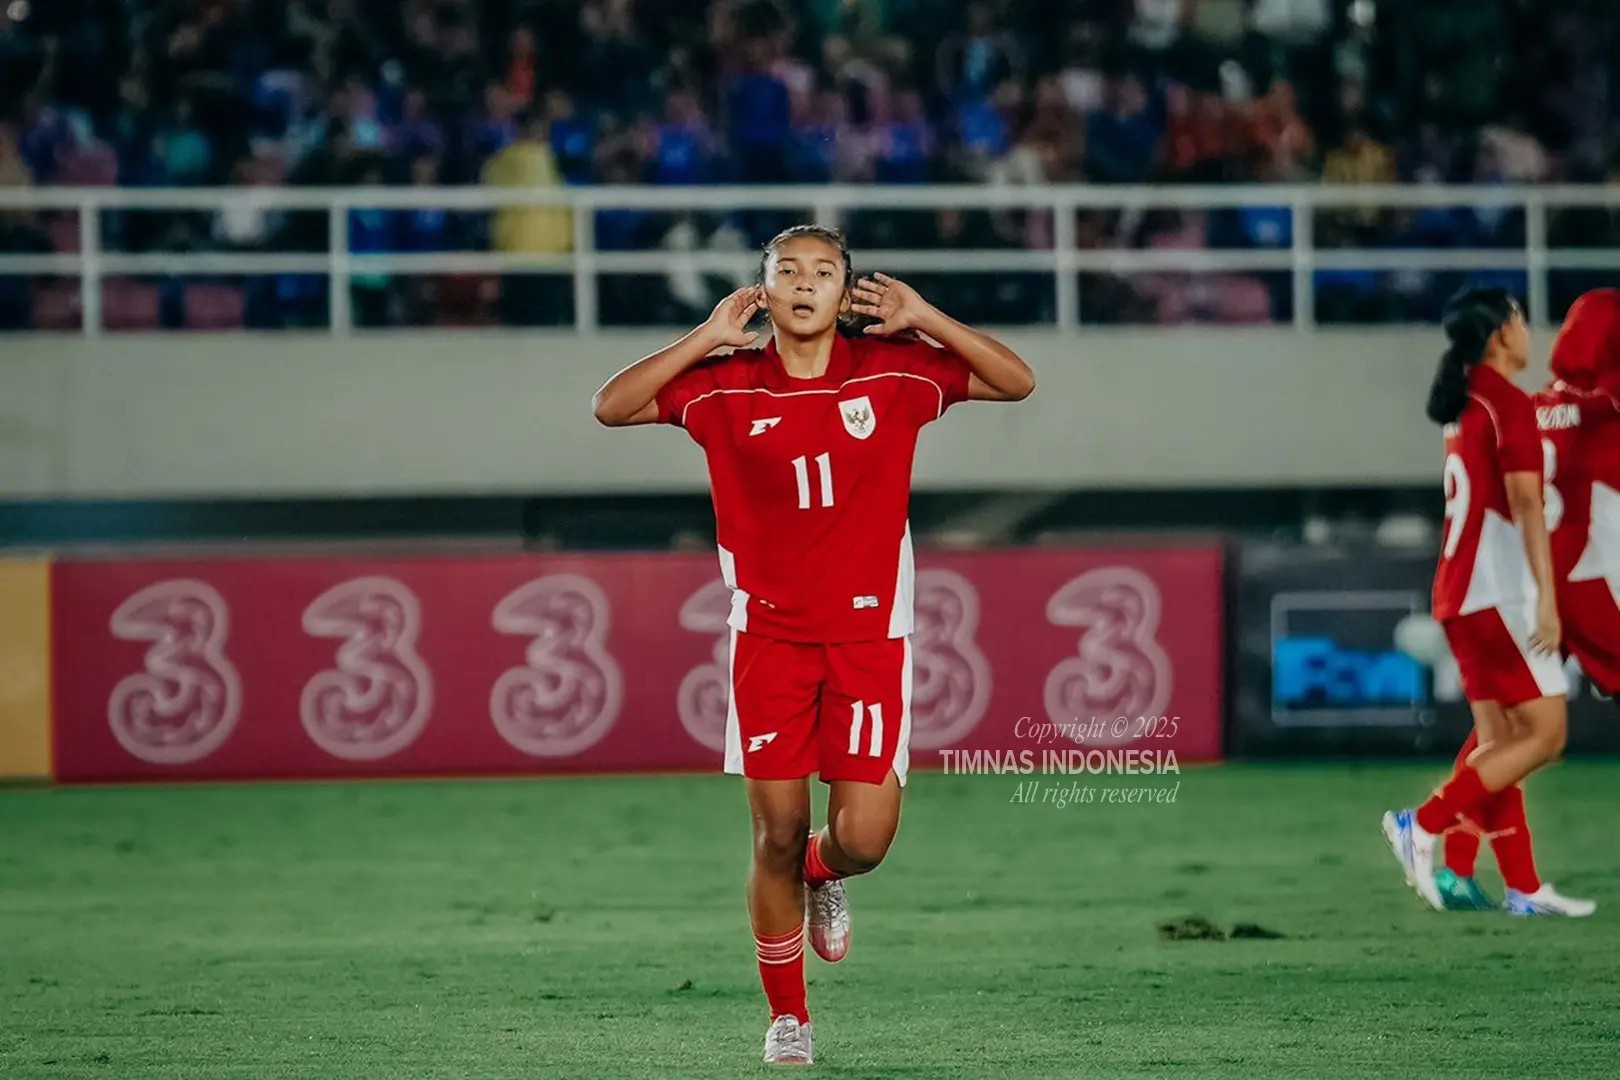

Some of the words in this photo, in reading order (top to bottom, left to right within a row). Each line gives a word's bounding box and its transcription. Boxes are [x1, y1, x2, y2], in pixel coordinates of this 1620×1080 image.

[791, 452, 834, 509] 11
[1443, 453, 1470, 559] 9
[848, 700, 883, 757] 11
